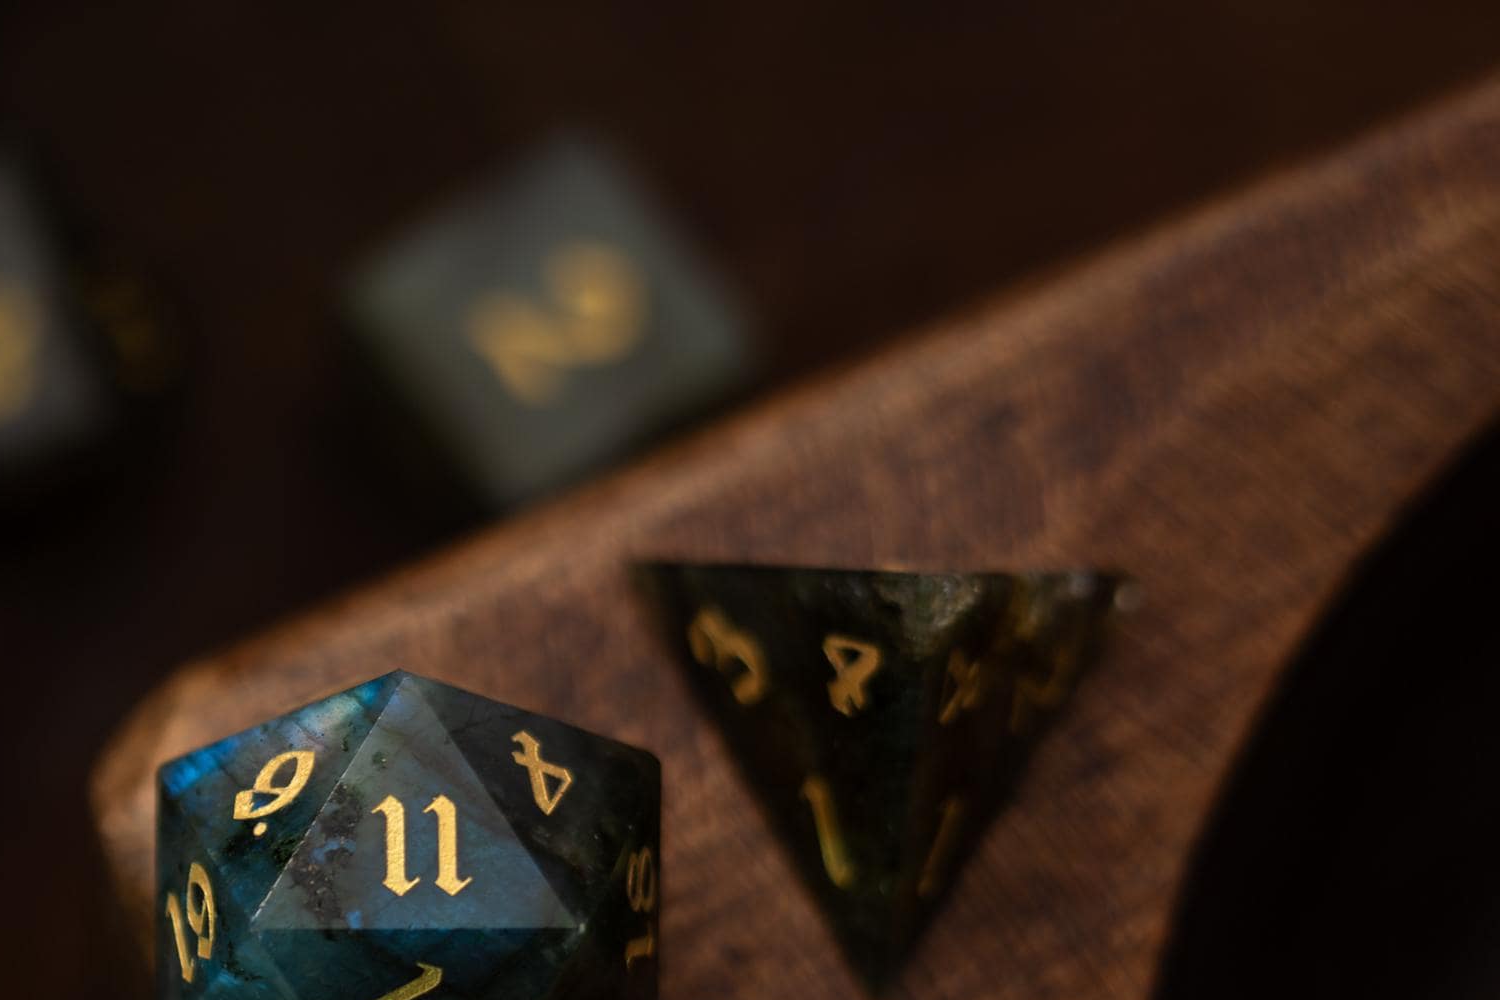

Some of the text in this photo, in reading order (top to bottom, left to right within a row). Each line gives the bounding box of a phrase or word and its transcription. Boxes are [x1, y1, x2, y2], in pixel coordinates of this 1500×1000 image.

[509, 729, 574, 817] 4
[370, 793, 474, 897] 11
[165, 861, 218, 985] 19
